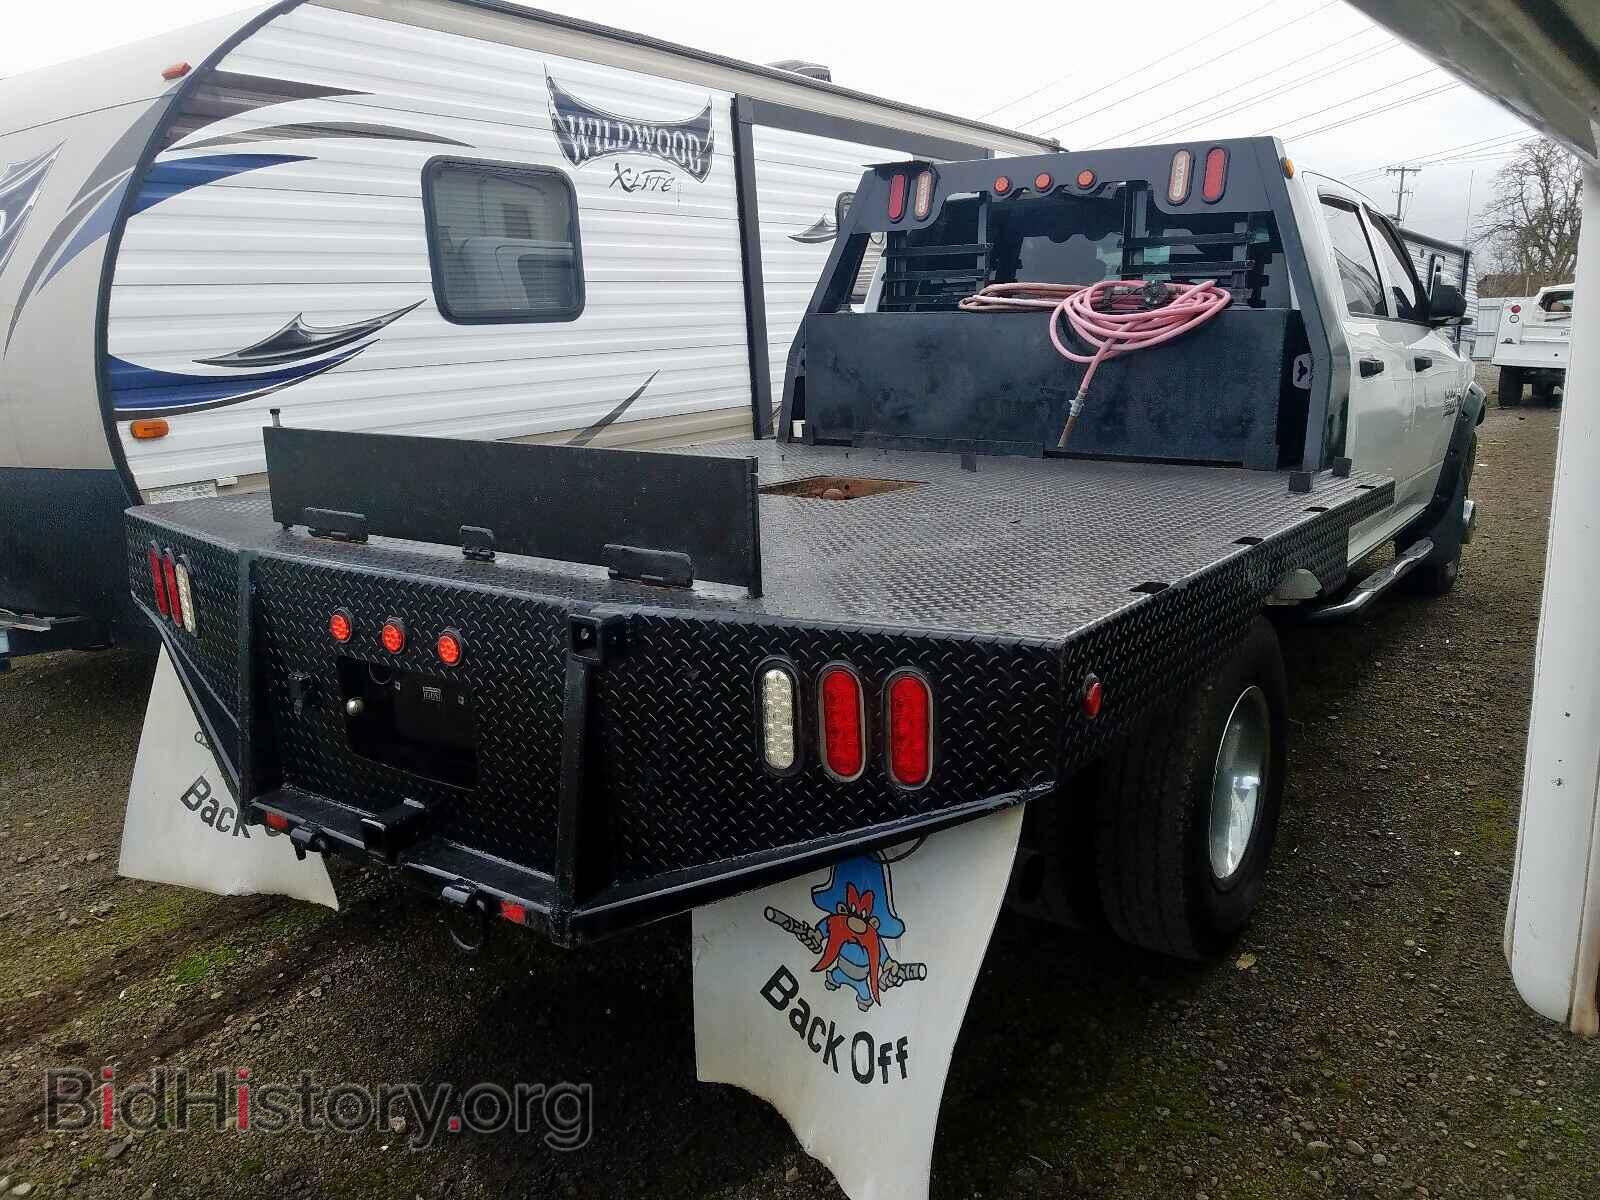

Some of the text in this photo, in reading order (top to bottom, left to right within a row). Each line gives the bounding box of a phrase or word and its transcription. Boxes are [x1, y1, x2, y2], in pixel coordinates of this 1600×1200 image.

[566, 114, 702, 174] WILDWOOD
[759, 964, 909, 1084] Back Off
